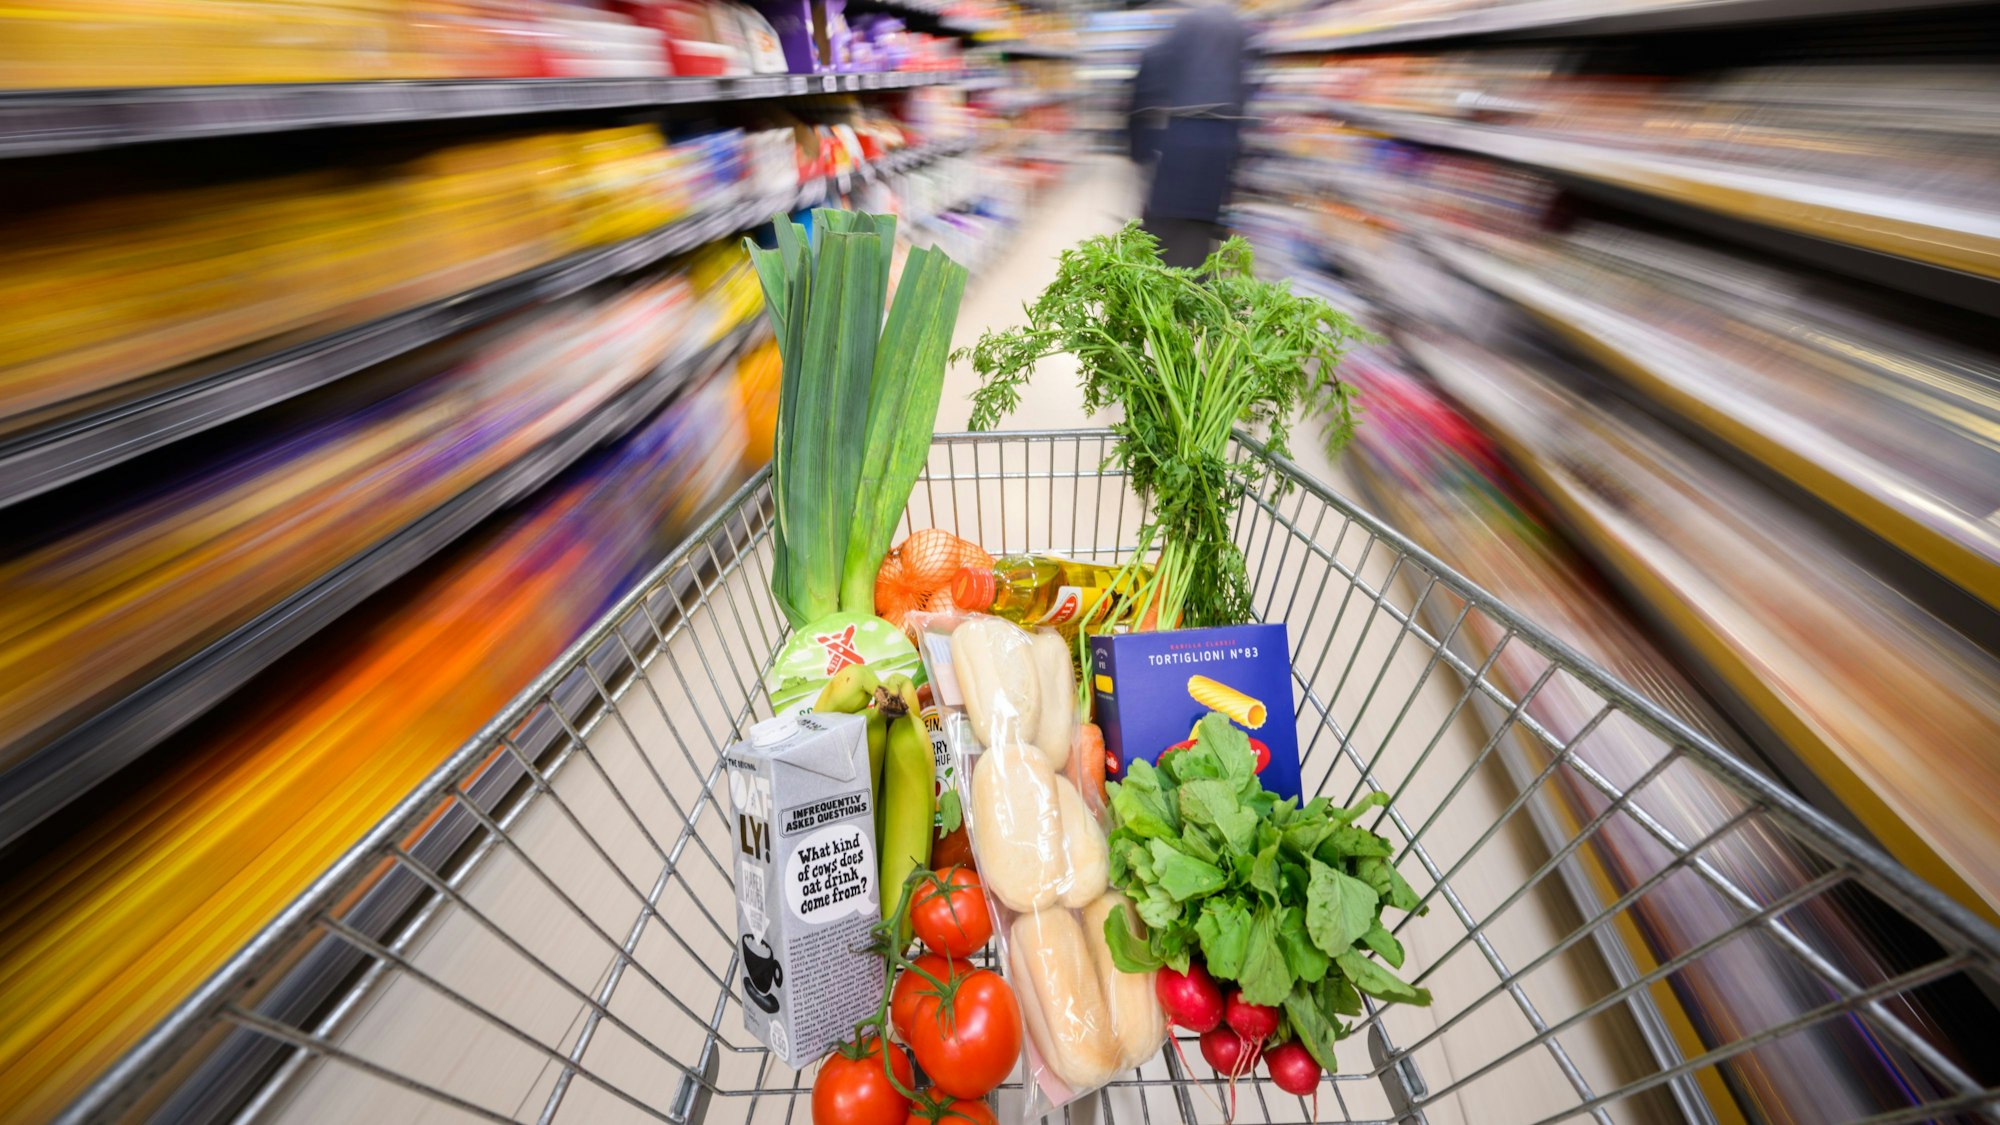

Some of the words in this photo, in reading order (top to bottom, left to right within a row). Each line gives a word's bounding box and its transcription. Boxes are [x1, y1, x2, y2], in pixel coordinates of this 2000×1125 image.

[1148, 649, 1225, 666] TORTIGLIONI
[924, 717, 943, 733] EIN
[785, 818, 815, 832] ASKED
[817, 802, 867, 823] QUESTIONS
[793, 794, 861, 820] INFREQUENTLY
[739, 813, 771, 864] LY!
[798, 842, 831, 864] What
[832, 833, 860, 855] kind
[797, 864, 810, 882] of
[812, 858, 838, 879] cows
[840, 849, 864, 867] does
[800, 893, 831, 914] come
[832, 876, 867, 904] from?
[802, 878, 823, 897] oat
[824, 866, 859, 890] drink
